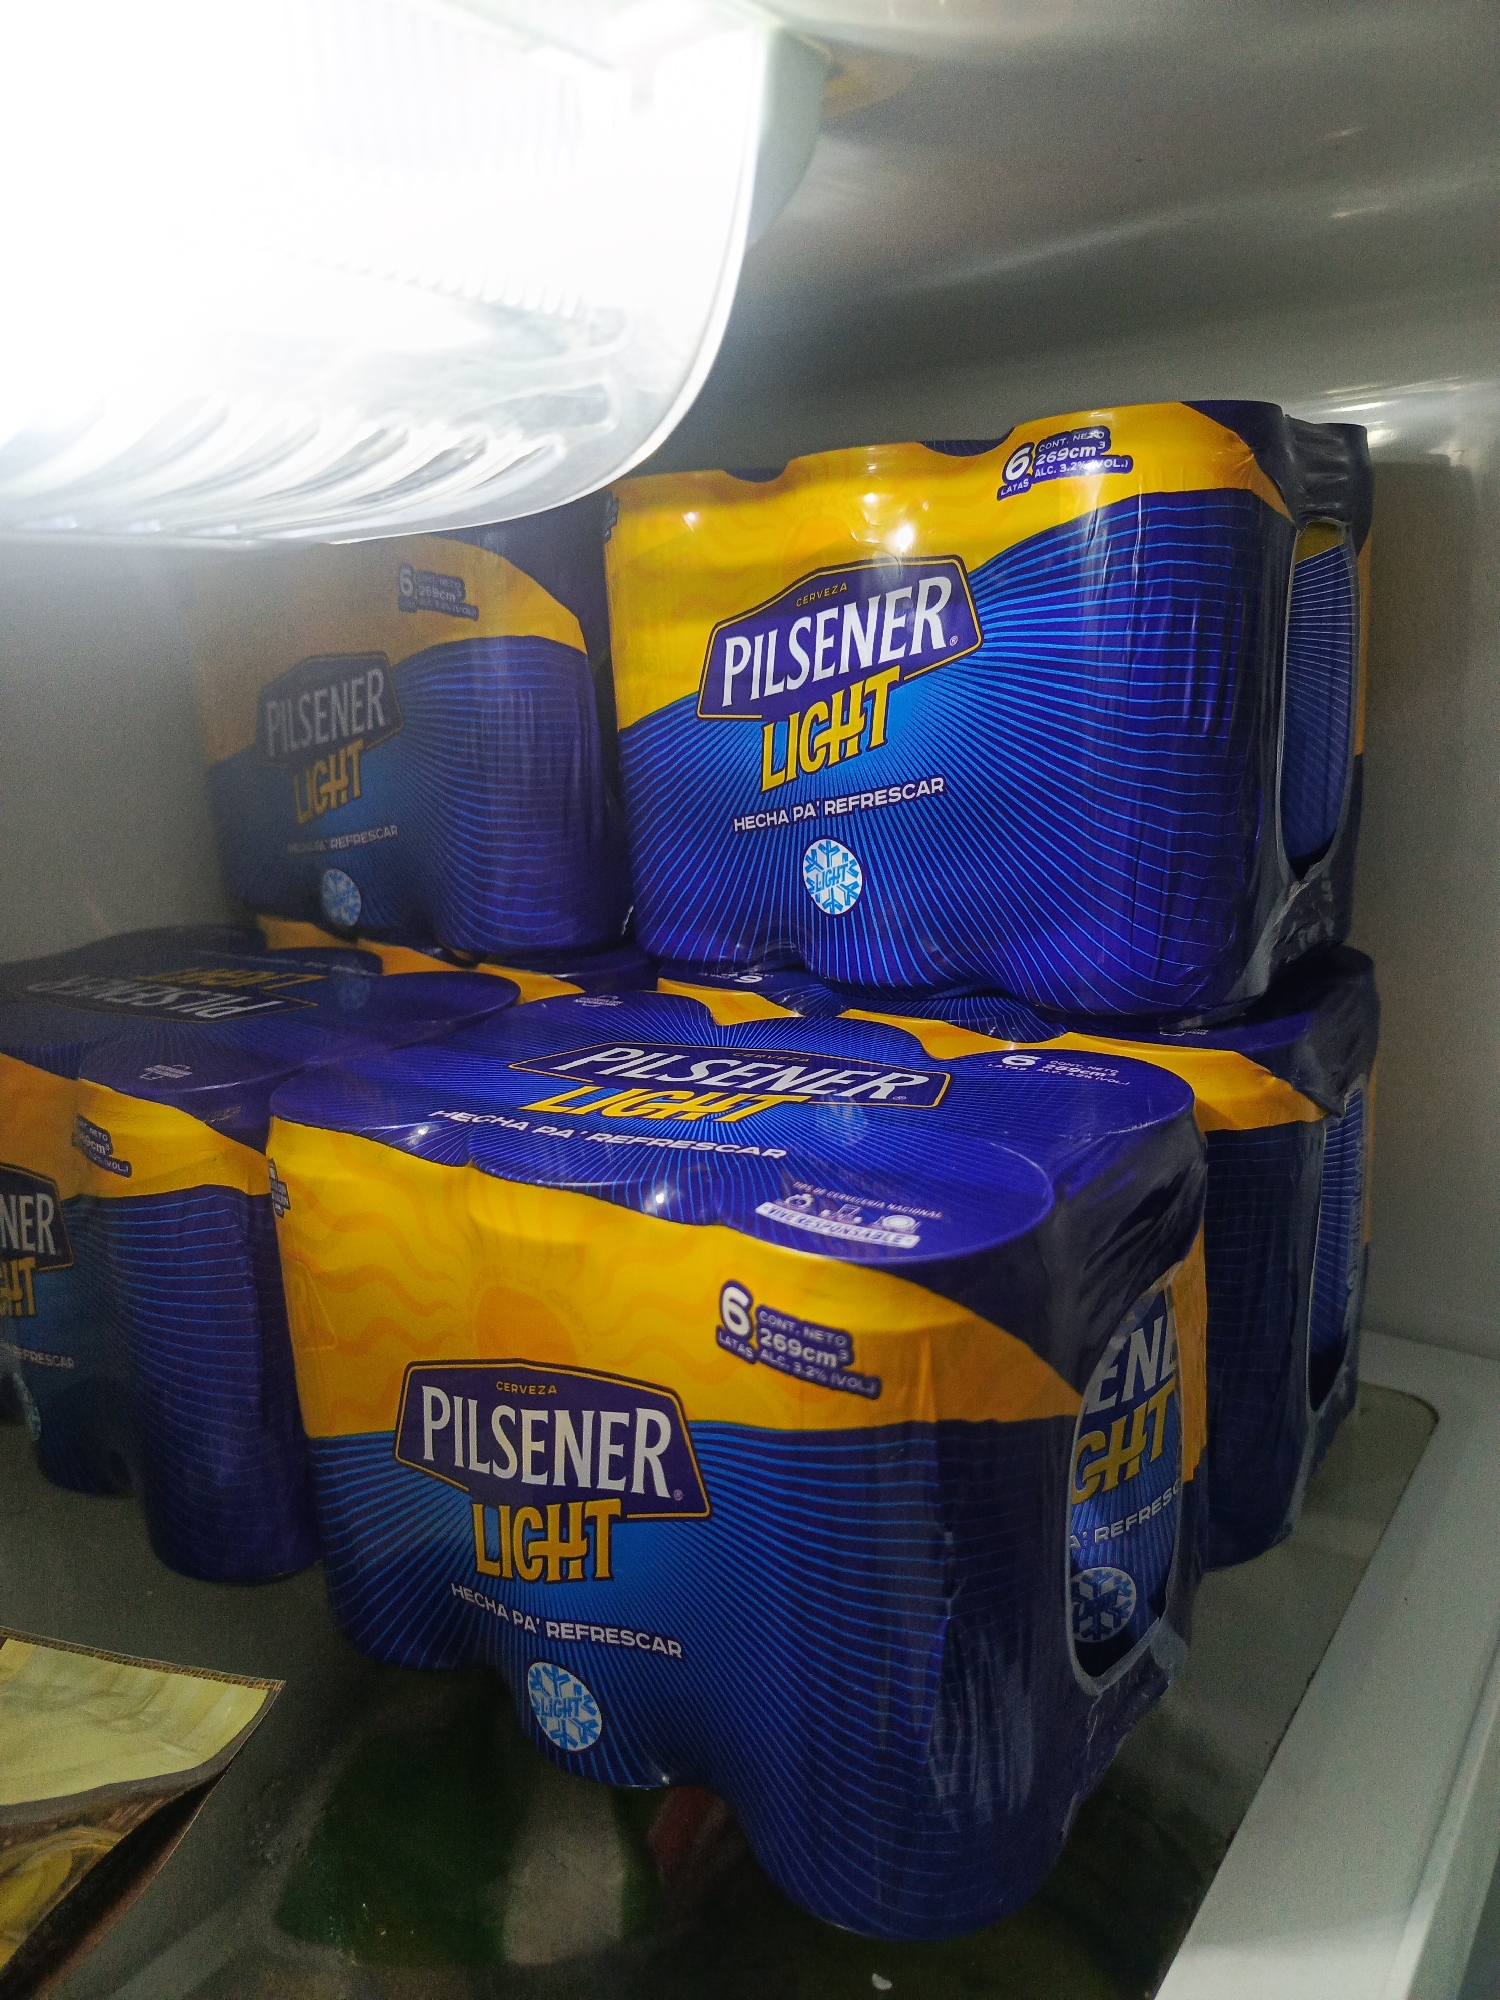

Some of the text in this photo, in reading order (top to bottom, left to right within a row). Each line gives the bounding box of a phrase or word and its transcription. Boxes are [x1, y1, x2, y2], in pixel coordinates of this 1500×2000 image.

[1005, 446, 1031, 480] 6
[1038, 437, 1070, 453] CONT.
[1000, 477, 1029, 496] LATAS
[1034, 465, 1057, 479] ALC.
[401, 568, 414, 597] 6
[796, 582, 848, 608] CERVEZA
[721, 576, 952, 707] PILSENER
[266, 668, 386, 757] PILSENER
[760, 664, 900, 792] LIGHT
[294, 738, 365, 826] LIGHT
[734, 777, 944, 832] HECHA PA' REFRESCAR
[330, 824, 400, 850] REFRESCAR
[815, 864, 849, 892] LIGHT
[554, 1047, 930, 1100] PILSENER
[1002, 1055, 1042, 1066] 6
[518, 1085, 812, 1123] LIGHT
[428, 1110, 528, 1132] HECHA
[585, 1133, 788, 1160] REFRESCAR
[722, 1286, 750, 1336] 6
[759, 1310, 848, 1347] CONT. NETO
[719, 1332, 754, 1359] LATAS
[760, 1348, 792, 1370] ALC.
[496, 1381, 557, 1396] CERVEZA
[422, 1385, 672, 1499] PILSENER
[471, 1498, 622, 1582] LIGHT
[451, 1582, 683, 1659] HECHA PA' REFRESCAR
